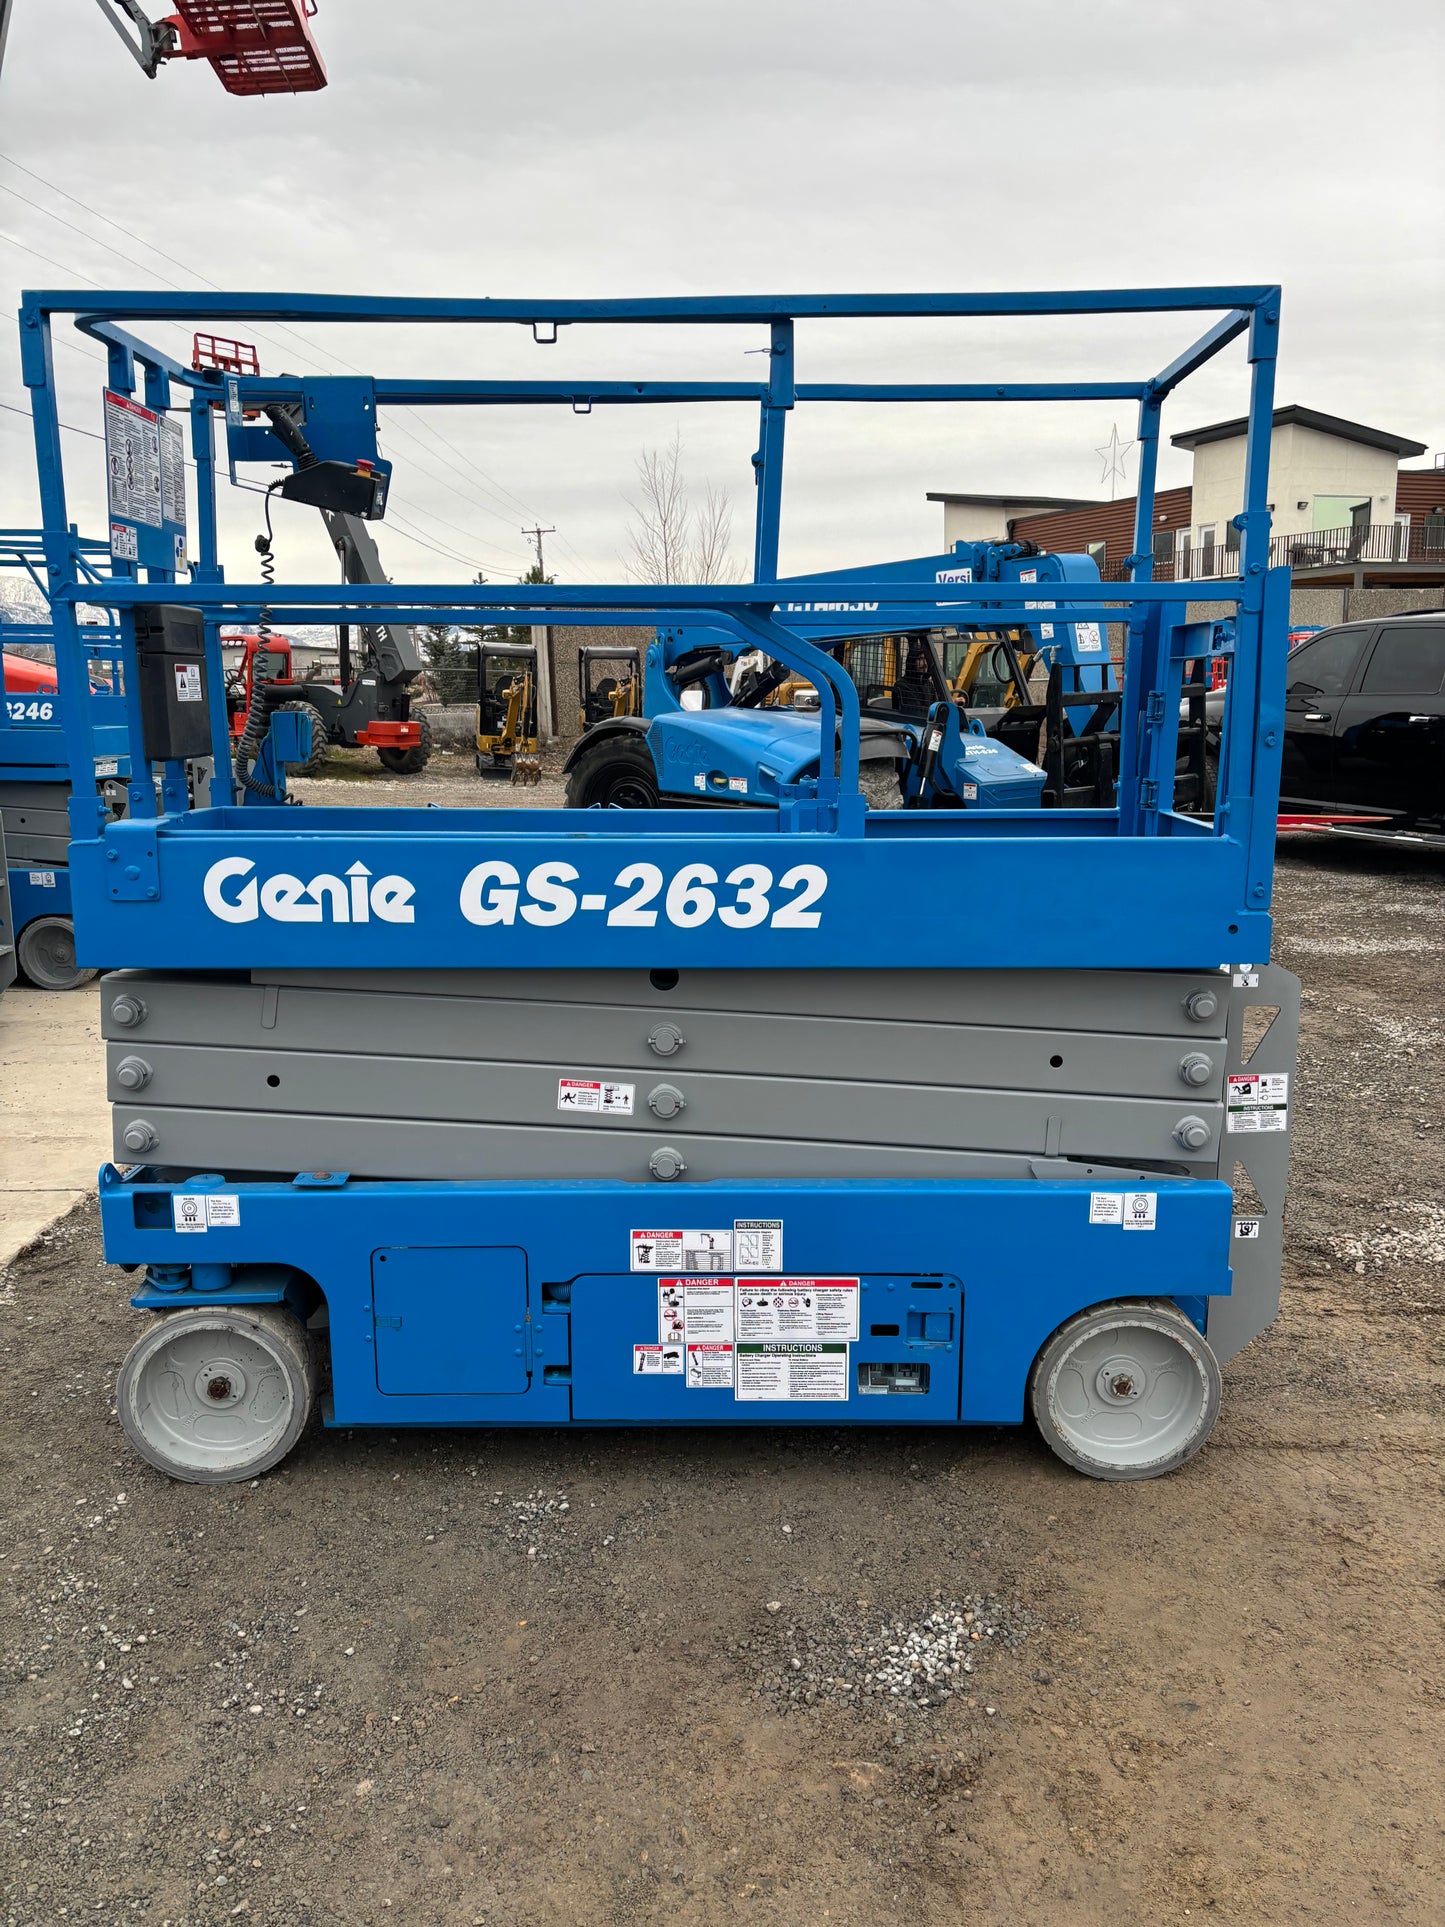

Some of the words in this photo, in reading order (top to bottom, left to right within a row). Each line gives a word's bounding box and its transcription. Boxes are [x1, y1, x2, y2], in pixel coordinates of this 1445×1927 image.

[203, 856, 416, 924] Genie
[459, 861, 828, 929] GS-2632
[736, 1221, 781, 1229] INSTRUCTIONS
[646, 1231, 674, 1239] DANGER
[685, 1278, 719, 1286] DANGER
[763, 1344, 823, 1352] INSTRUCTIONS
